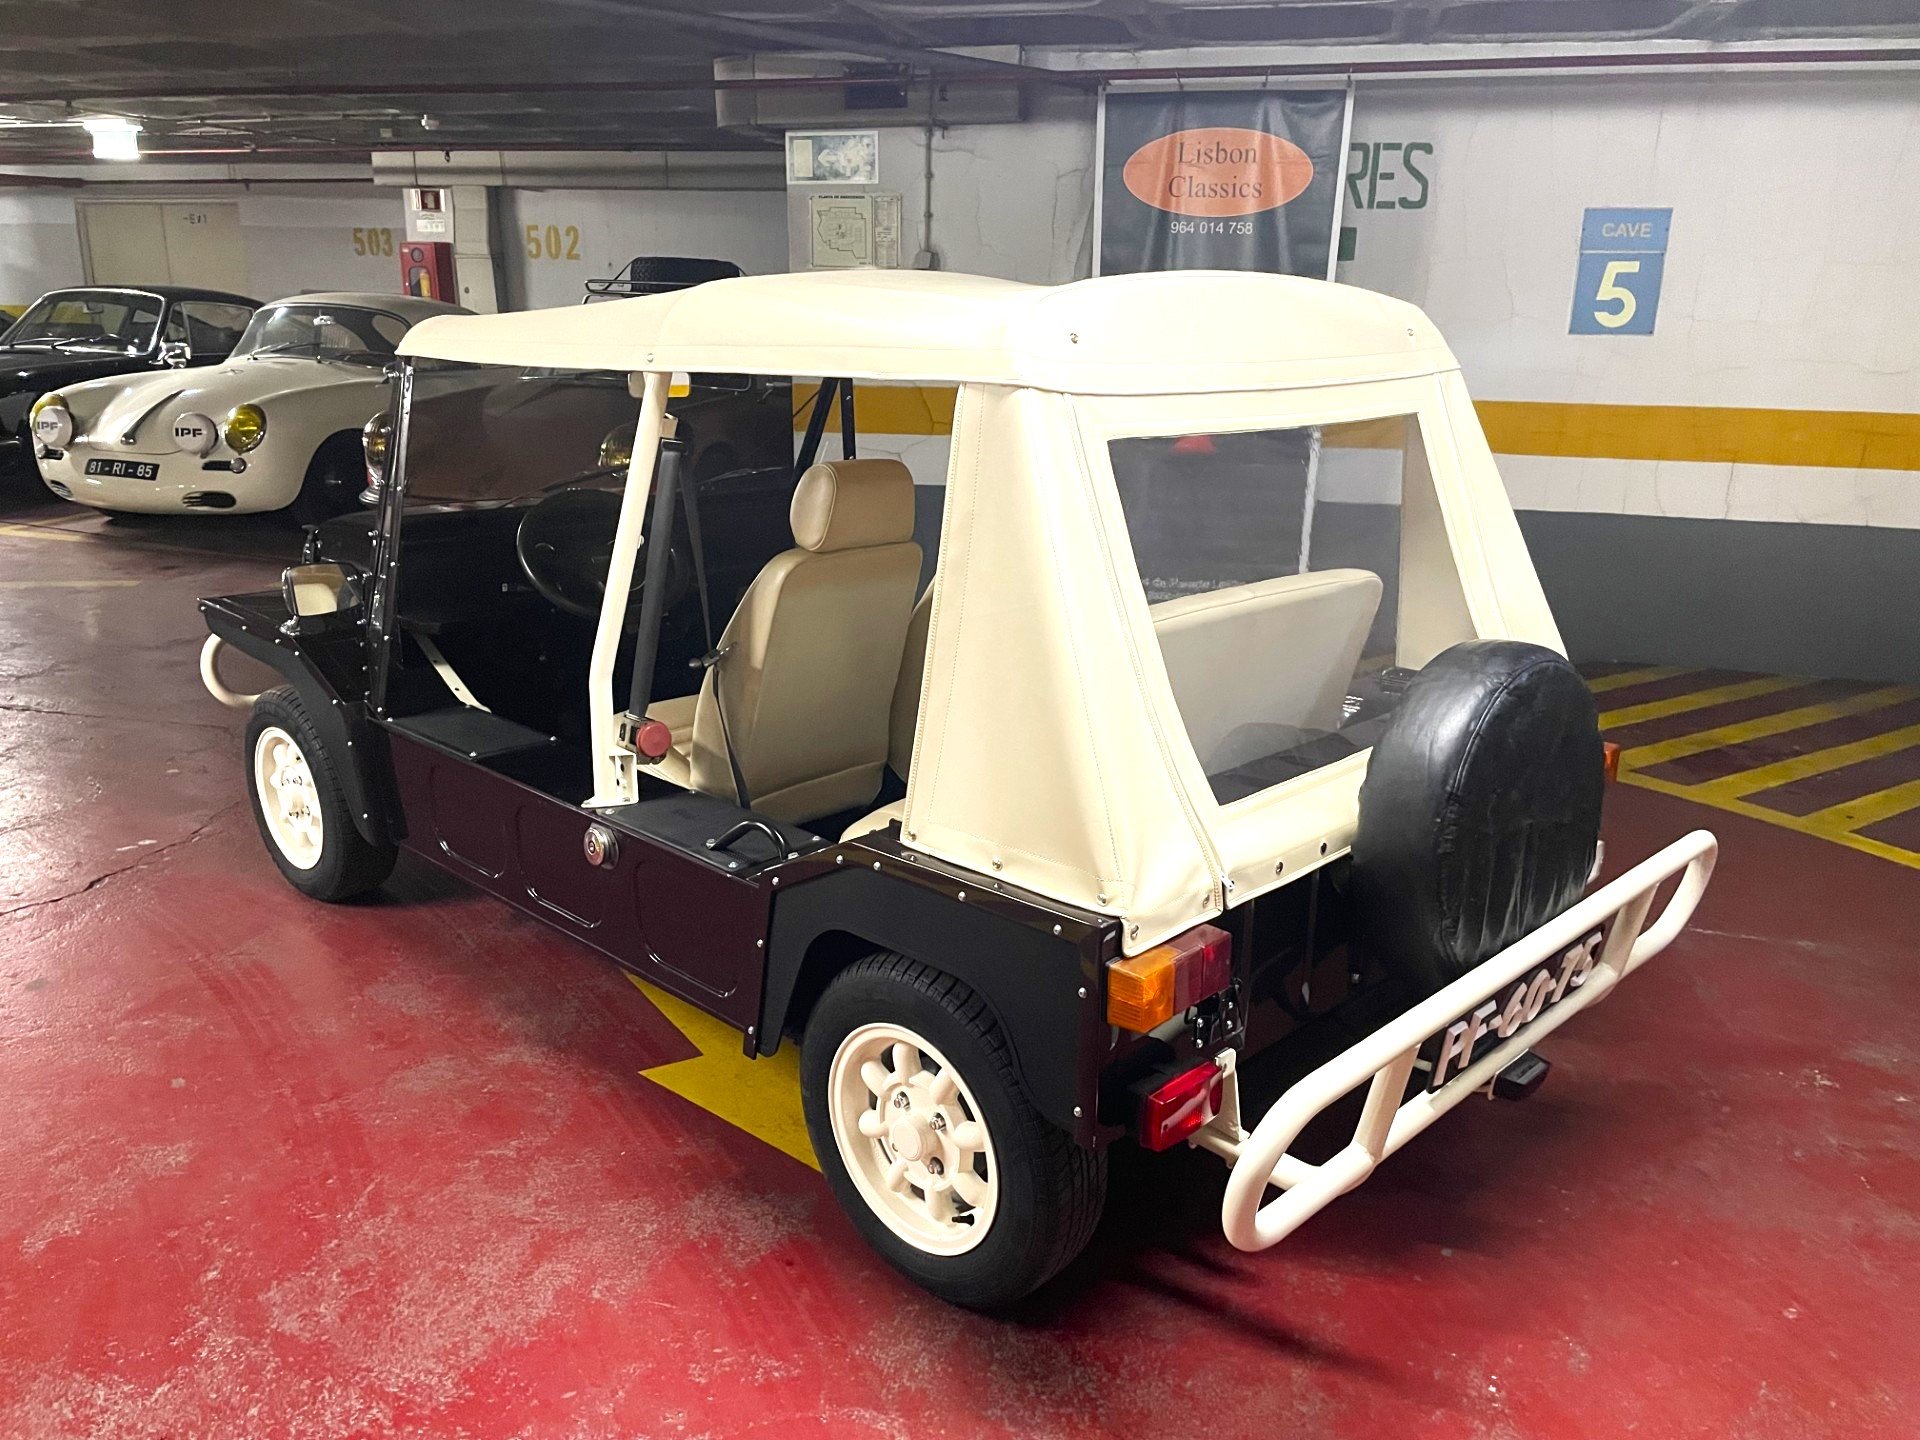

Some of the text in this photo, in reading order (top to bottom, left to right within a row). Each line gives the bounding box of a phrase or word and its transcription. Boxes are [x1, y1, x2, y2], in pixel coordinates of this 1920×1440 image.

[1178, 141, 1258, 164] Lisbon
[1168, 175, 1263, 199] Classics
[1170, 221, 1253, 234] 964 014 758
[1601, 222, 1653, 238] CAVE
[352, 227, 394, 257] 503
[526, 224, 581, 260] 502
[1593, 260, 1641, 328] 5
[37, 421, 59, 431] IPF
[174, 427, 203, 437] IPF
